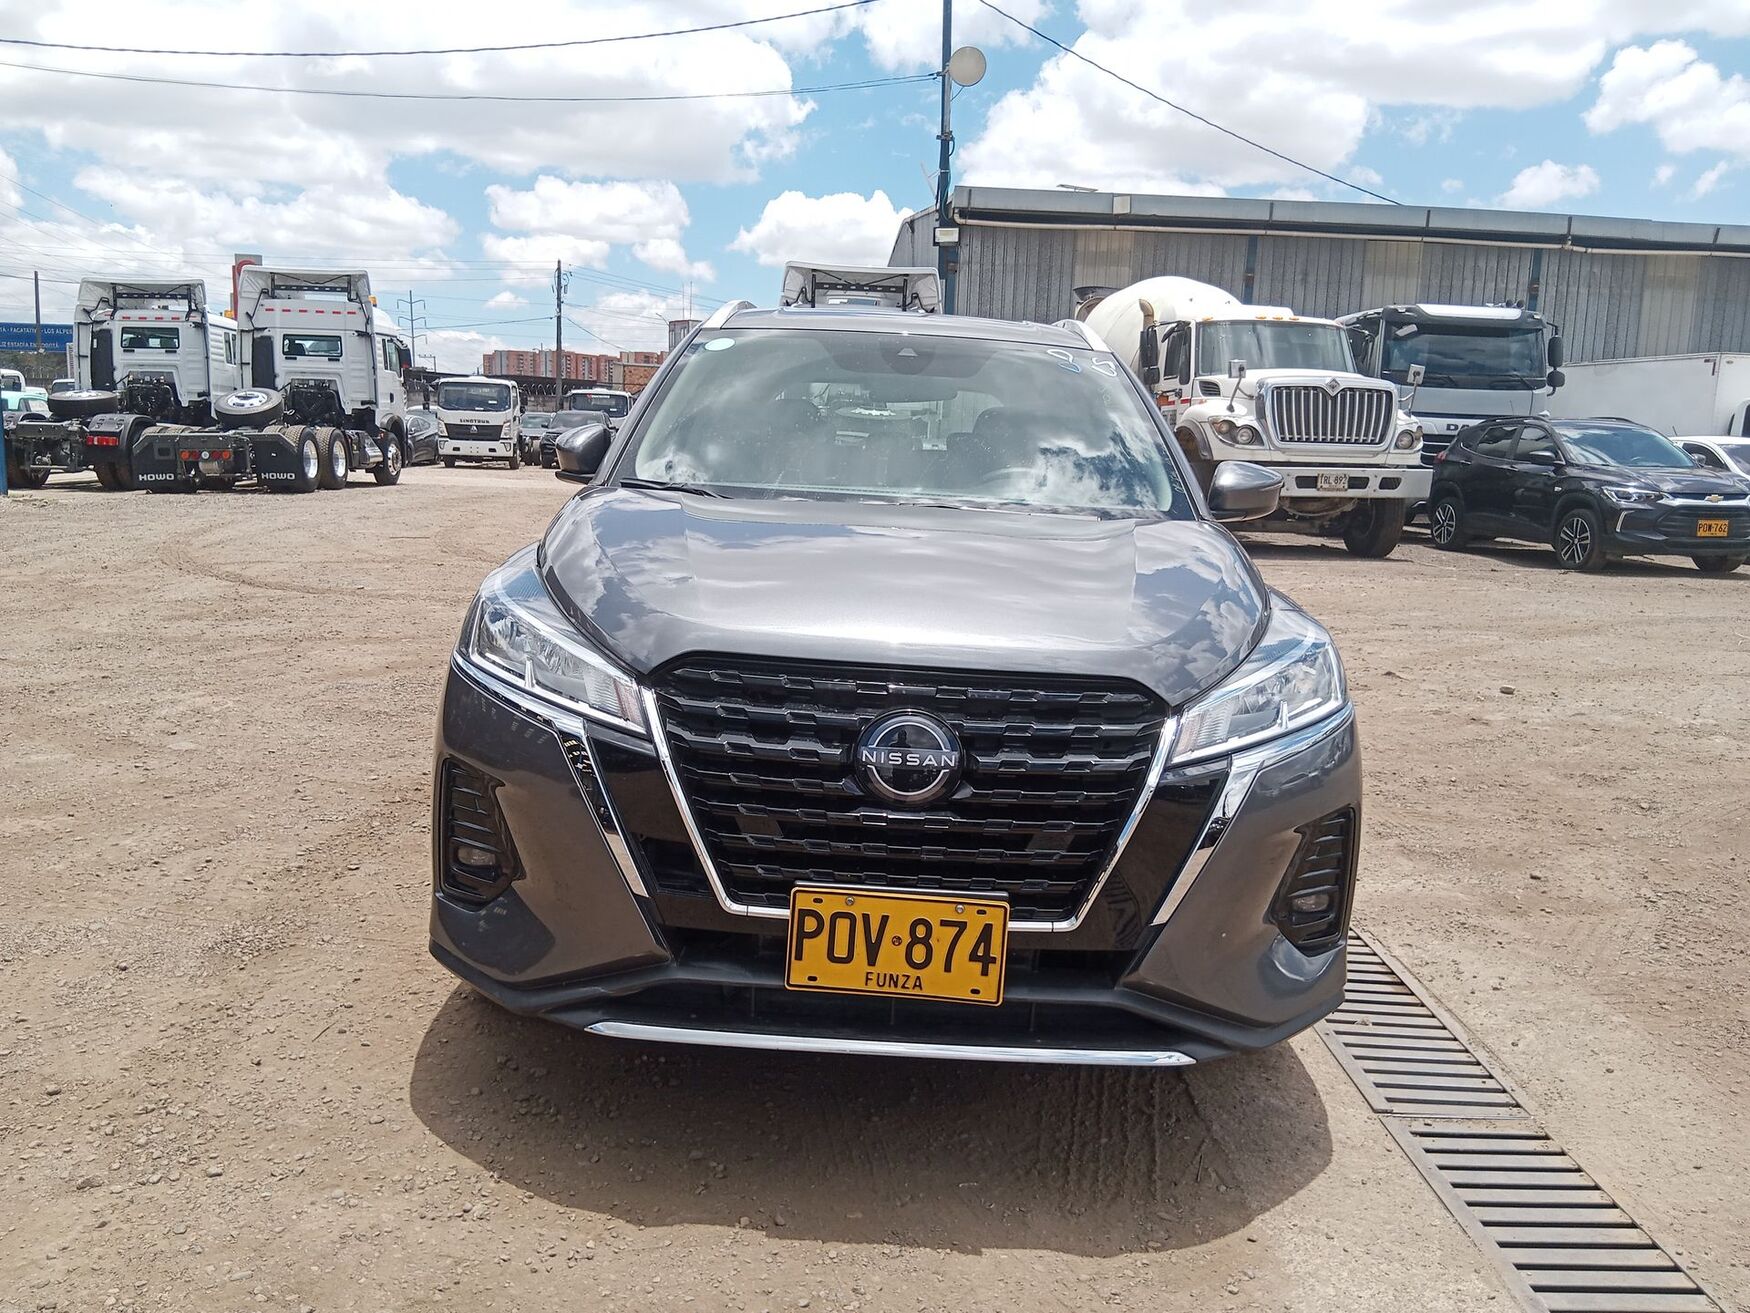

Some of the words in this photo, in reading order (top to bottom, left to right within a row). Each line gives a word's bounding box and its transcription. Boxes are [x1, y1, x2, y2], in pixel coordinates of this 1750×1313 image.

[138, 473, 175, 481] HOWO
[261, 472, 296, 480] HOWO
[862, 750, 956, 767] NISSAN
[864, 971, 923, 991] FUNZA
